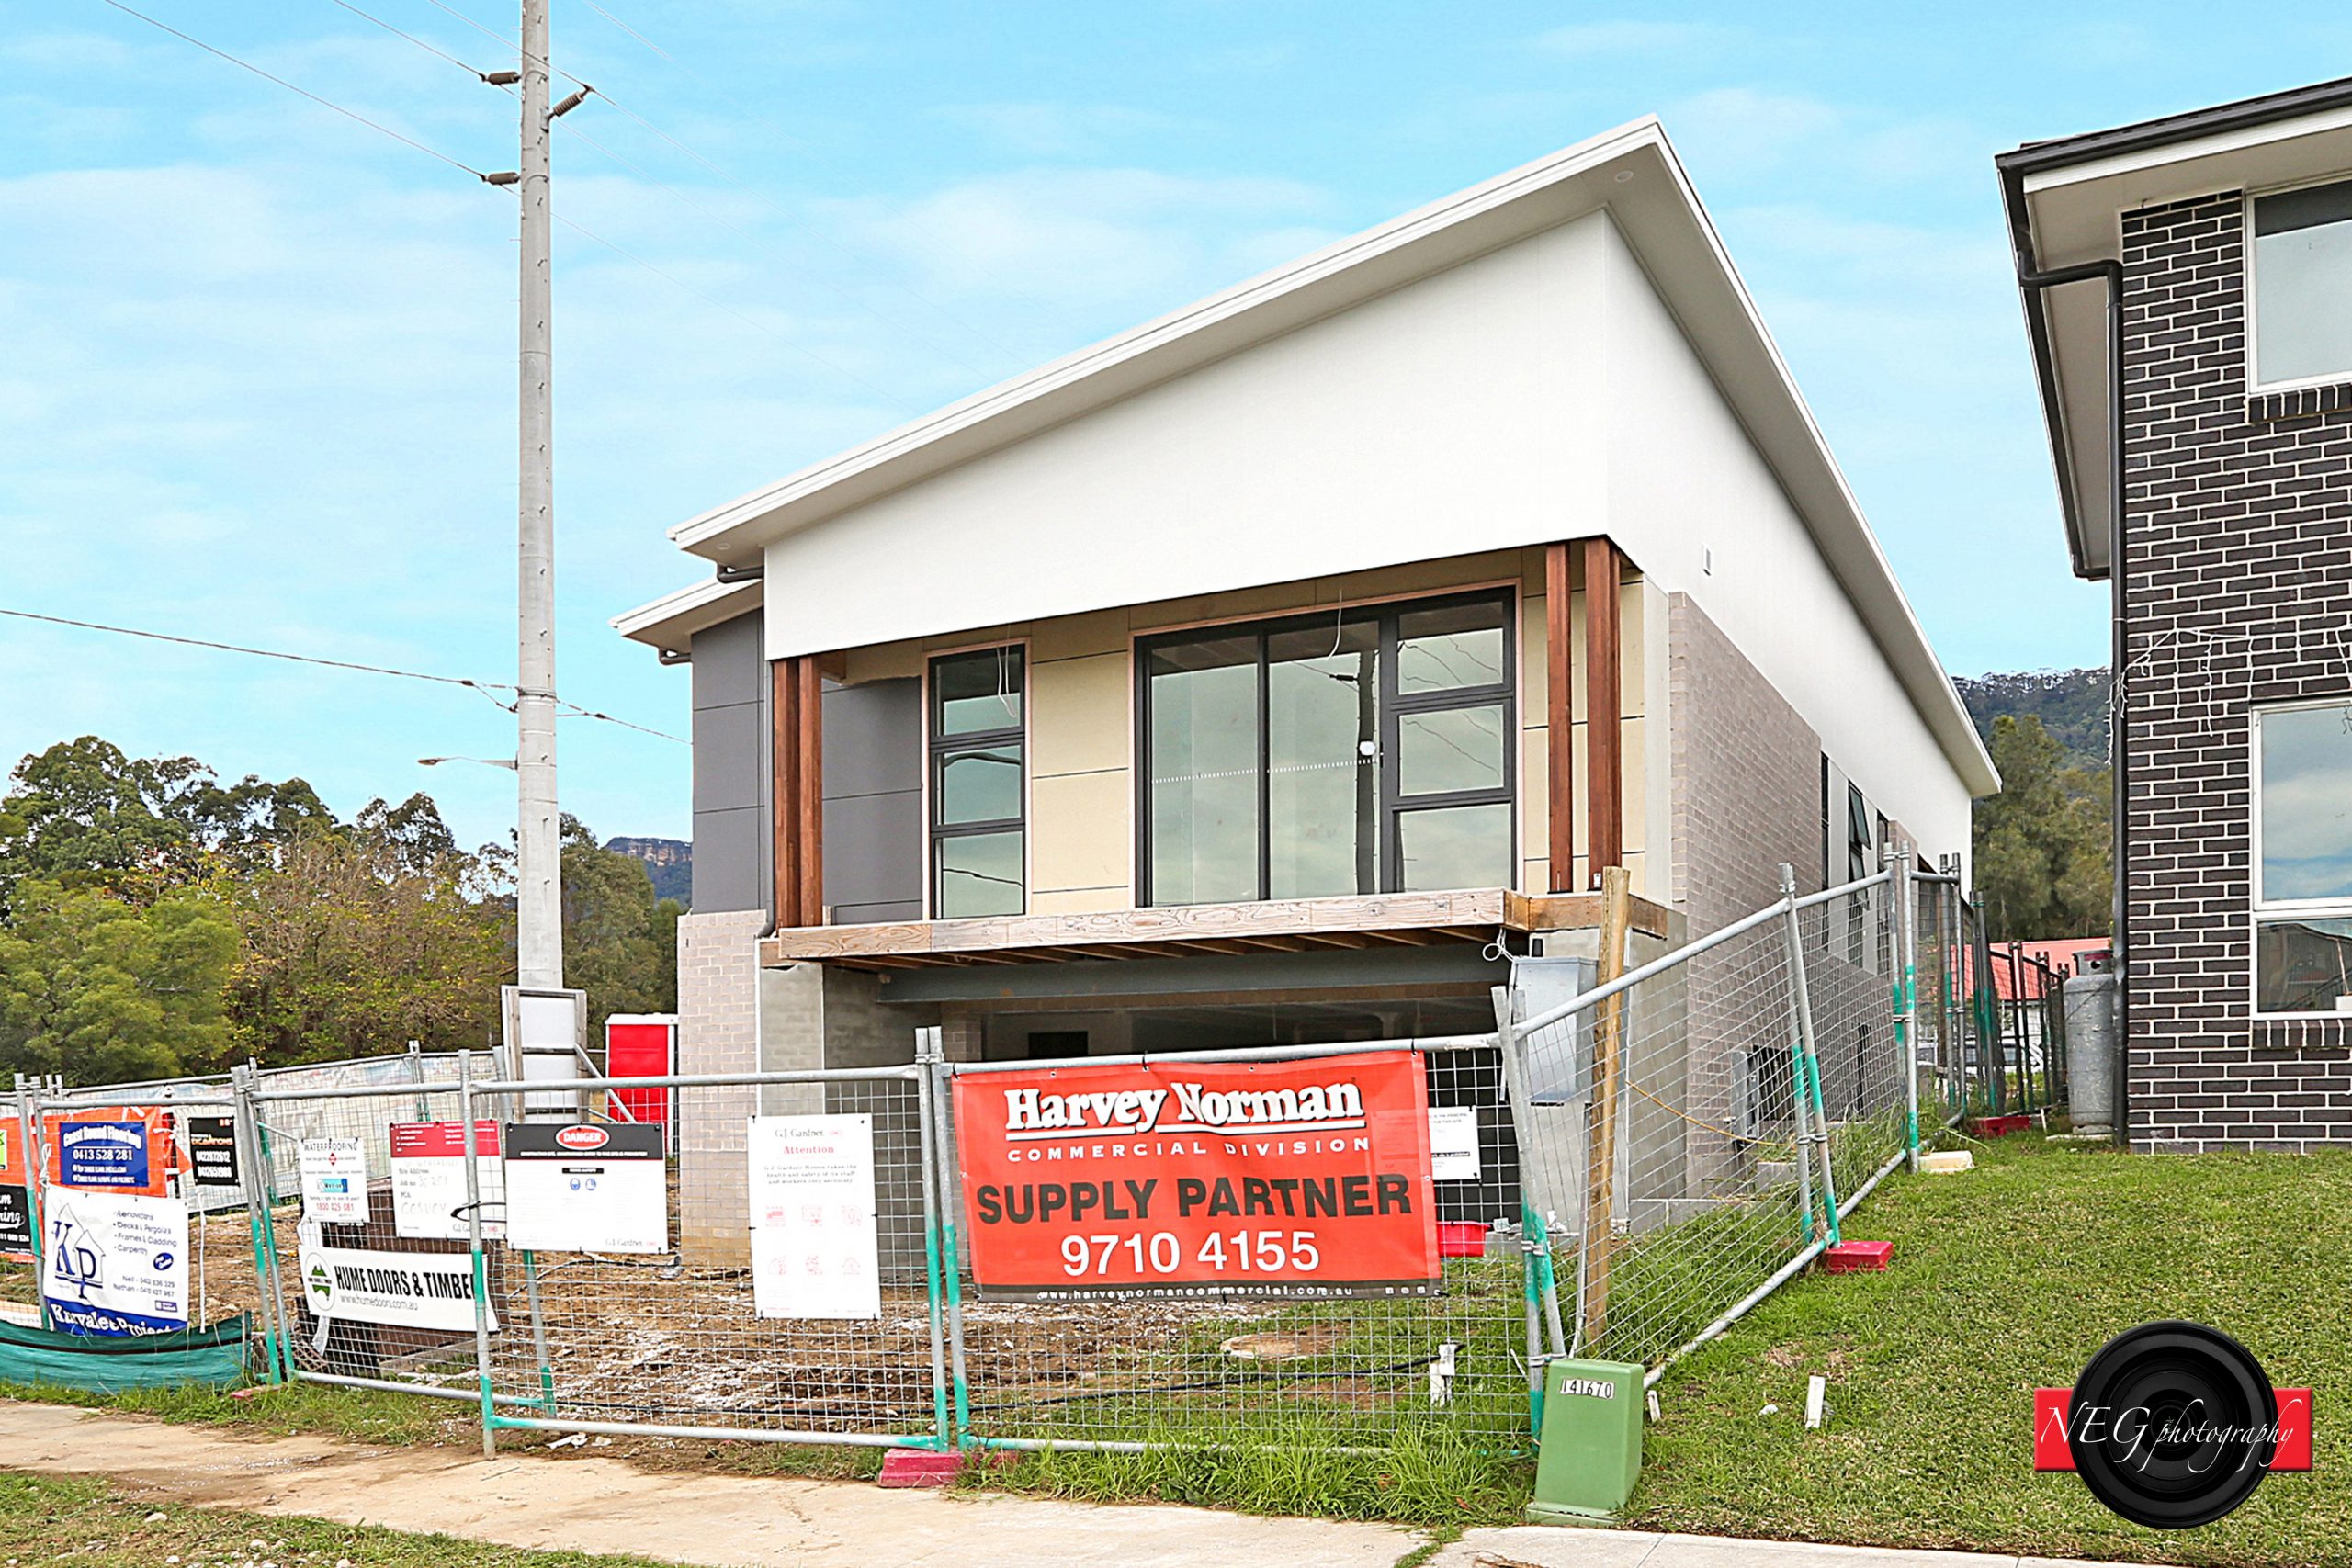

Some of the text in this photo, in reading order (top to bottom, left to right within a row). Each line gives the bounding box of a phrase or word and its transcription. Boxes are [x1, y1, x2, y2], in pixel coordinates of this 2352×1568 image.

[1004, 1082, 1363, 1134] Harvey Norman
[304, 1141, 357, 1152] WATERPROOFING
[562, 1133, 602, 1143] DANGER
[73, 1149, 133, 1161] 0413 528 281
[783, 1145, 835, 1155] Attention
[1007, 1137, 1370, 1162] COMMERCIAL DIVISION
[977, 1172, 1413, 1224] SUPPLY PARTNER
[117, 1221, 139, 1231] Decks
[117, 1232, 141, 1242] Frames
[1060, 1229, 1320, 1277] 9710 4155
[334, 1265, 367, 1292] HUME
[367, 1268, 412, 1296] DOORS
[412, 1272, 424, 1298] &
[1039, 1285, 1353, 1302] www.harveynormancommercial.com.au
[1563, 1379, 1613, 1399] 141670
